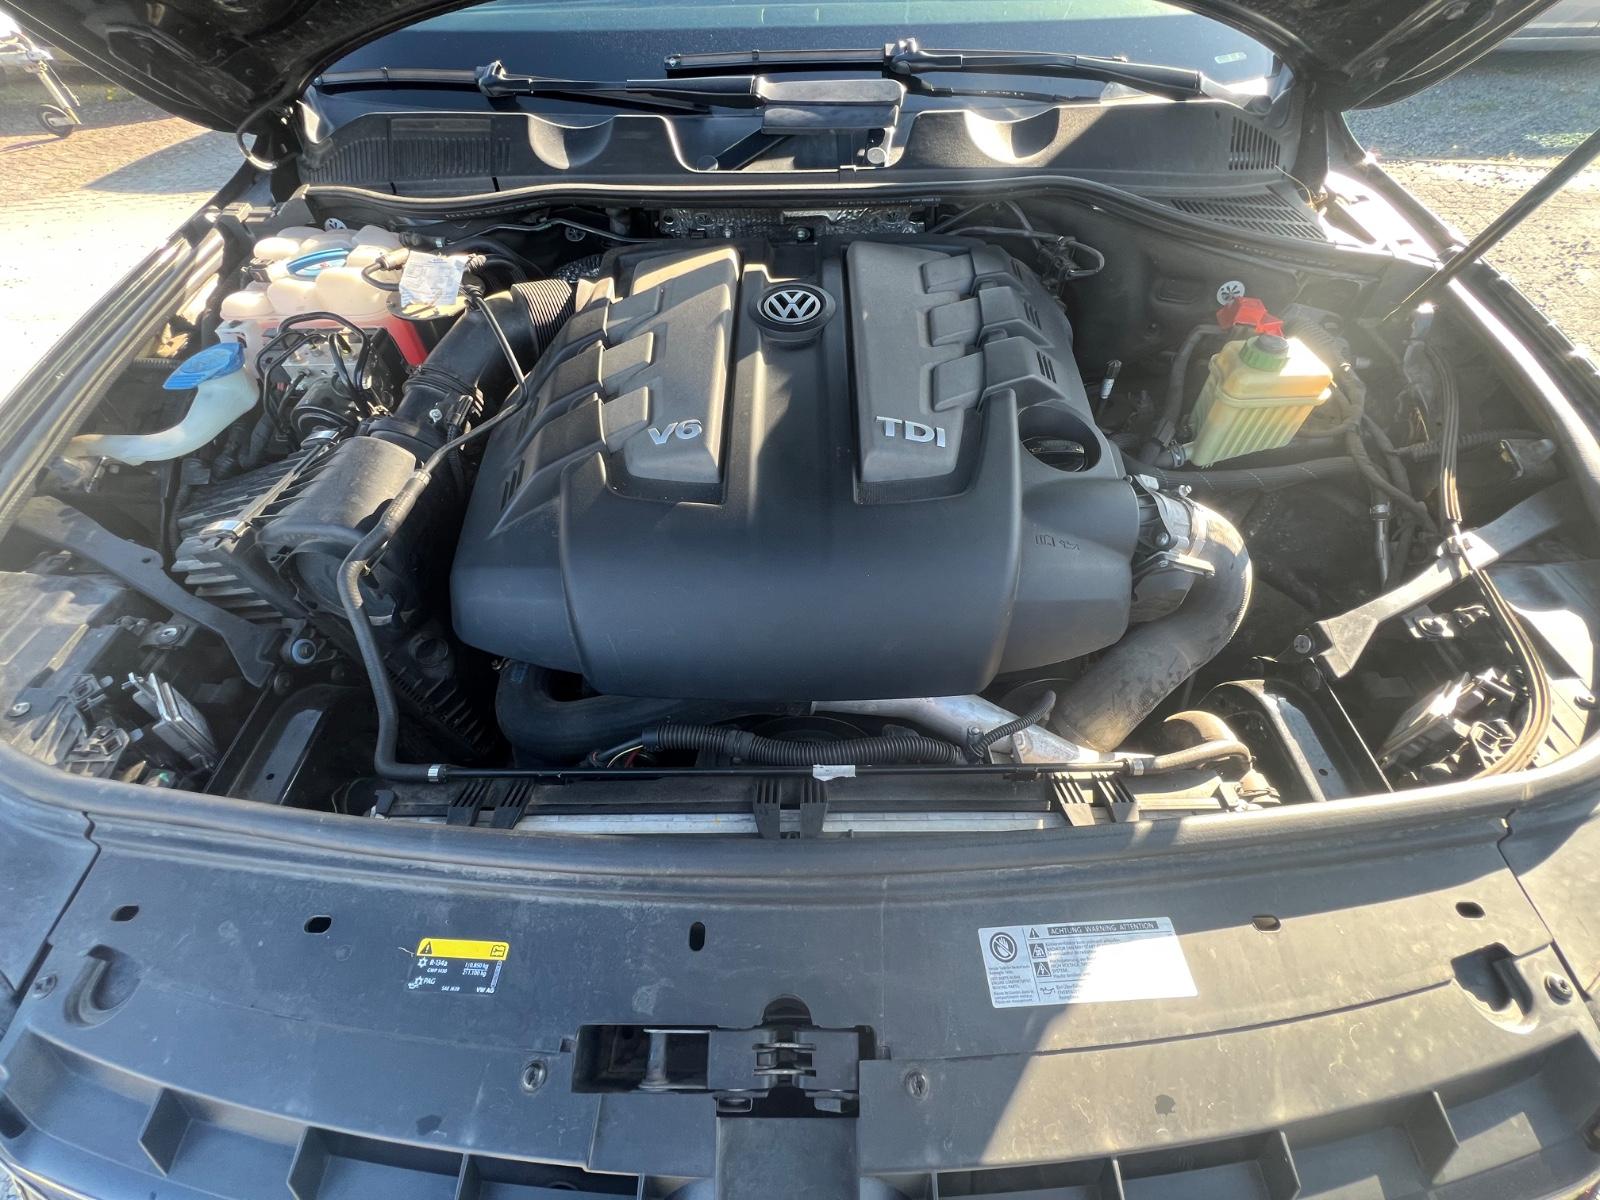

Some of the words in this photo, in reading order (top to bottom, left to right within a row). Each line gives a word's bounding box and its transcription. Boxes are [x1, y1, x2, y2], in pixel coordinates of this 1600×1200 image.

[648, 418, 703, 445] V6
[876, 415, 946, 448] TDI
[1050, 926, 1083, 935] ACHTUNG
[1085, 924, 1117, 933] WARNING
[1119, 921, 1154, 931] ATTENTION
[423, 977, 437, 985] PAG
